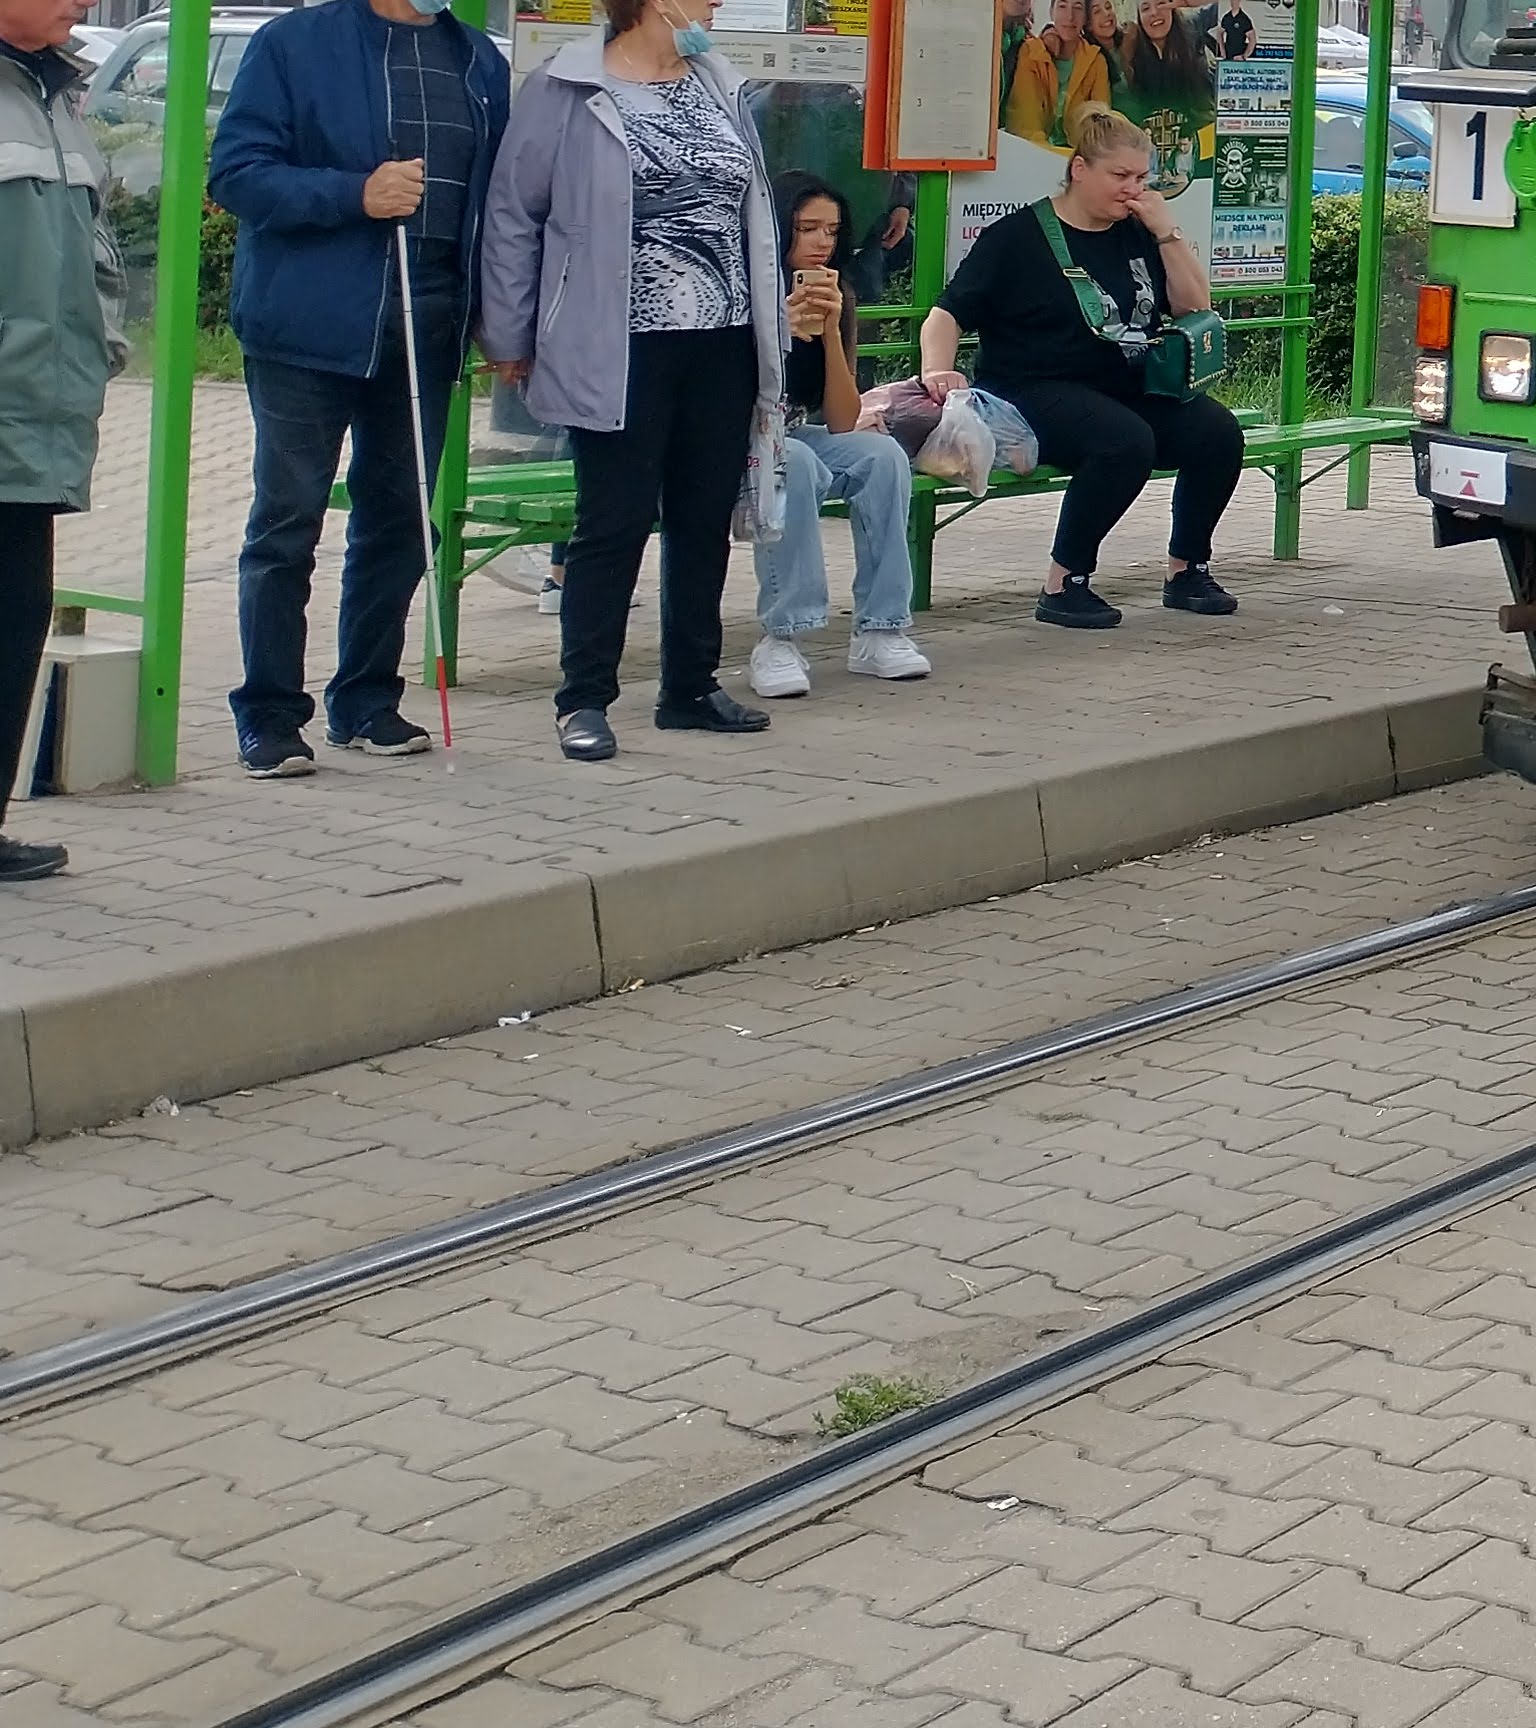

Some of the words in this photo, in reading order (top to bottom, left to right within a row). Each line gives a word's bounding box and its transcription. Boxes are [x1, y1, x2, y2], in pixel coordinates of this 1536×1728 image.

[1466, 111, 1487, 201] 1
[1215, 214, 1245, 222] MIEJSCE
[1246, 214, 1257, 222] NA
[962, 226, 987, 240] LIC
